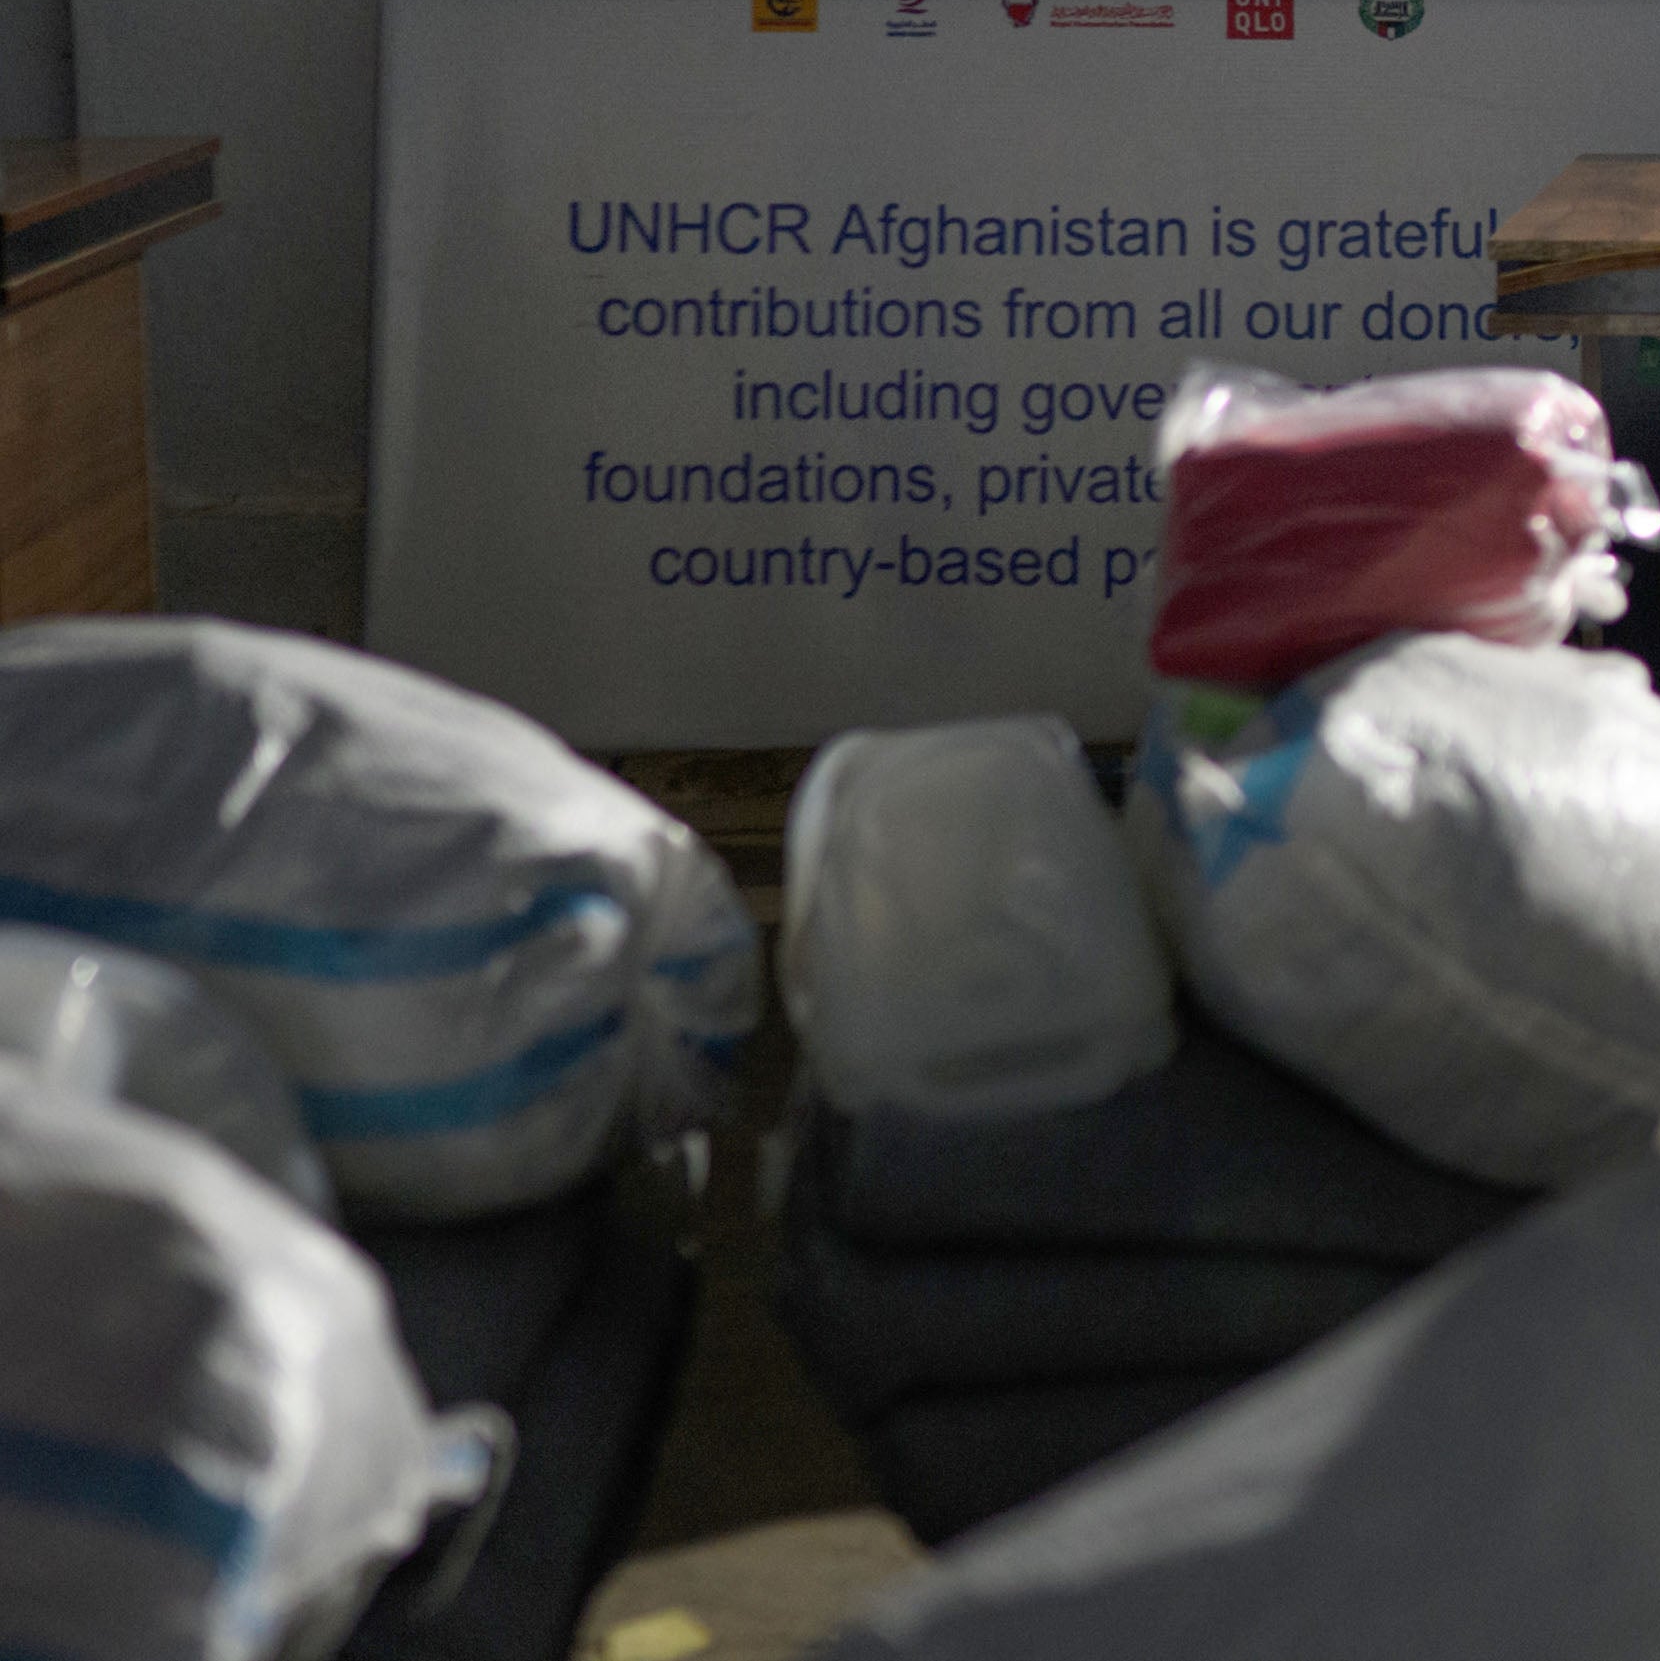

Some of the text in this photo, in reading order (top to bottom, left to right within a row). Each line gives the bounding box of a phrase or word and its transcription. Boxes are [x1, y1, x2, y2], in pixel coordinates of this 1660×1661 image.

[1235, 11, 1286, 37] QLO
[569, 201, 811, 255] UNHCR
[830, 201, 1188, 270] Afghanistan
[1212, 205, 1257, 259] is
[596, 286, 983, 339] contributions
[1003, 286, 1136, 340] from
[1158, 288, 1222, 340] all
[1245, 301, 1342, 341] our
[734, 369, 999, 436] including
[583, 449, 952, 510] foundations,
[649, 534, 1080, 600] country-based
